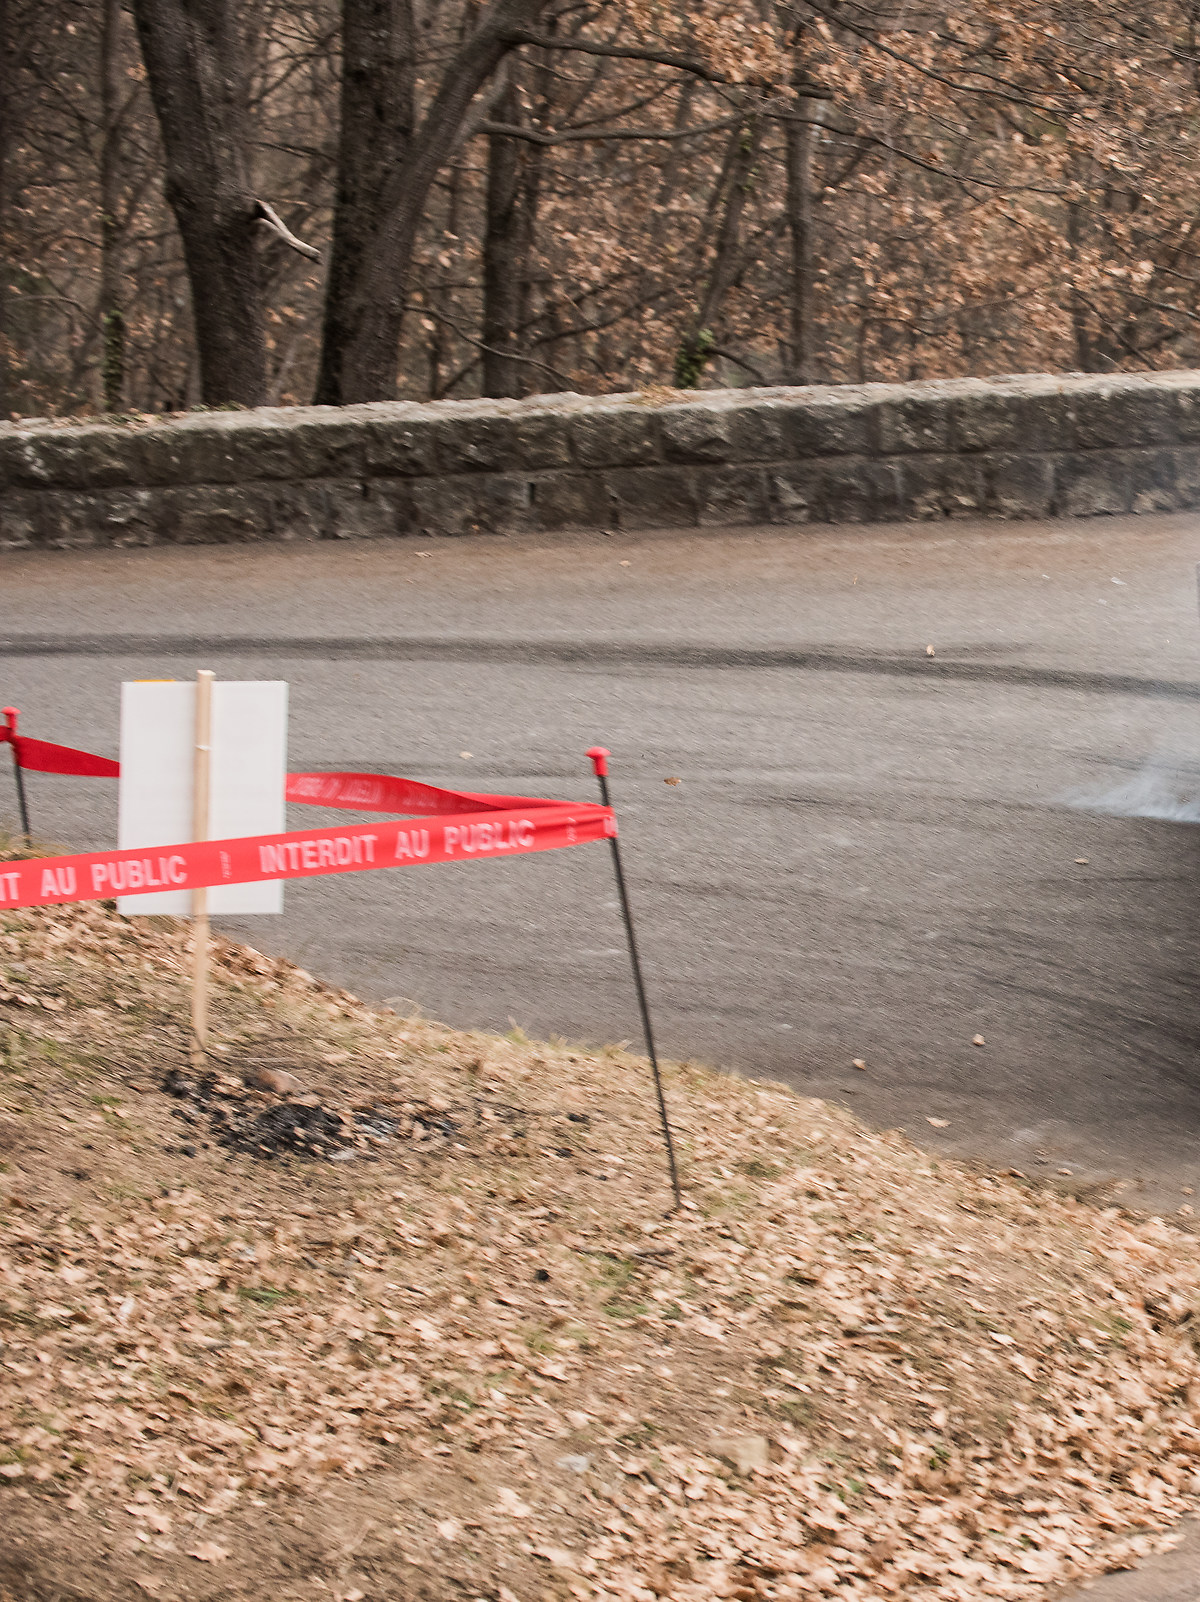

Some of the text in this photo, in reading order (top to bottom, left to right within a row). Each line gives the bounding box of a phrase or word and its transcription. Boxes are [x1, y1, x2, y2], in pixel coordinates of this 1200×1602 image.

[41, 867, 77, 897] AU
[91, 855, 188, 892] PUBLIC
[259, 834, 379, 874] INTERDIT
[395, 829, 430, 860] AU
[443, 819, 536, 855] PUBLIC
